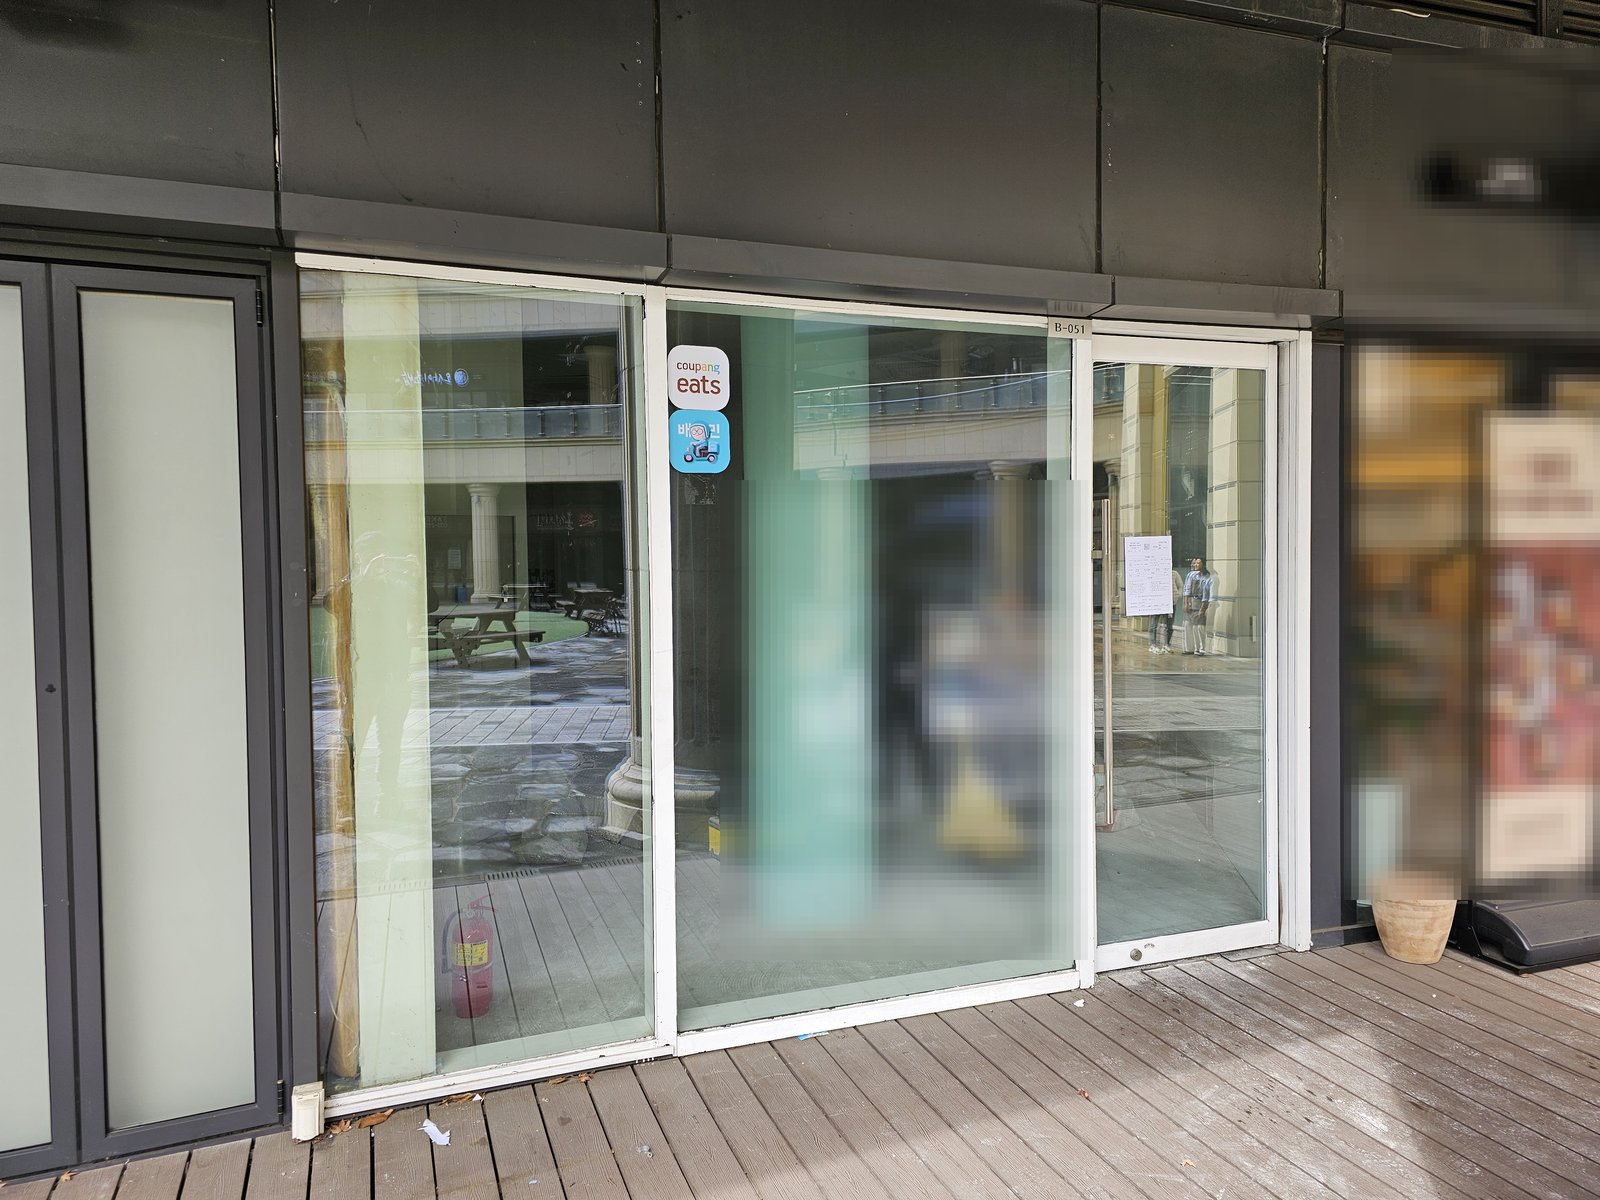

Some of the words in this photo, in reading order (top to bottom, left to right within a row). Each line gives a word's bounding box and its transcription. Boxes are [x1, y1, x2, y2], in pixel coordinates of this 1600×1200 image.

[1055, 322, 1085, 334] B-051
[676, 361, 720, 375] coupang
[677, 375, 721, 395] eats
